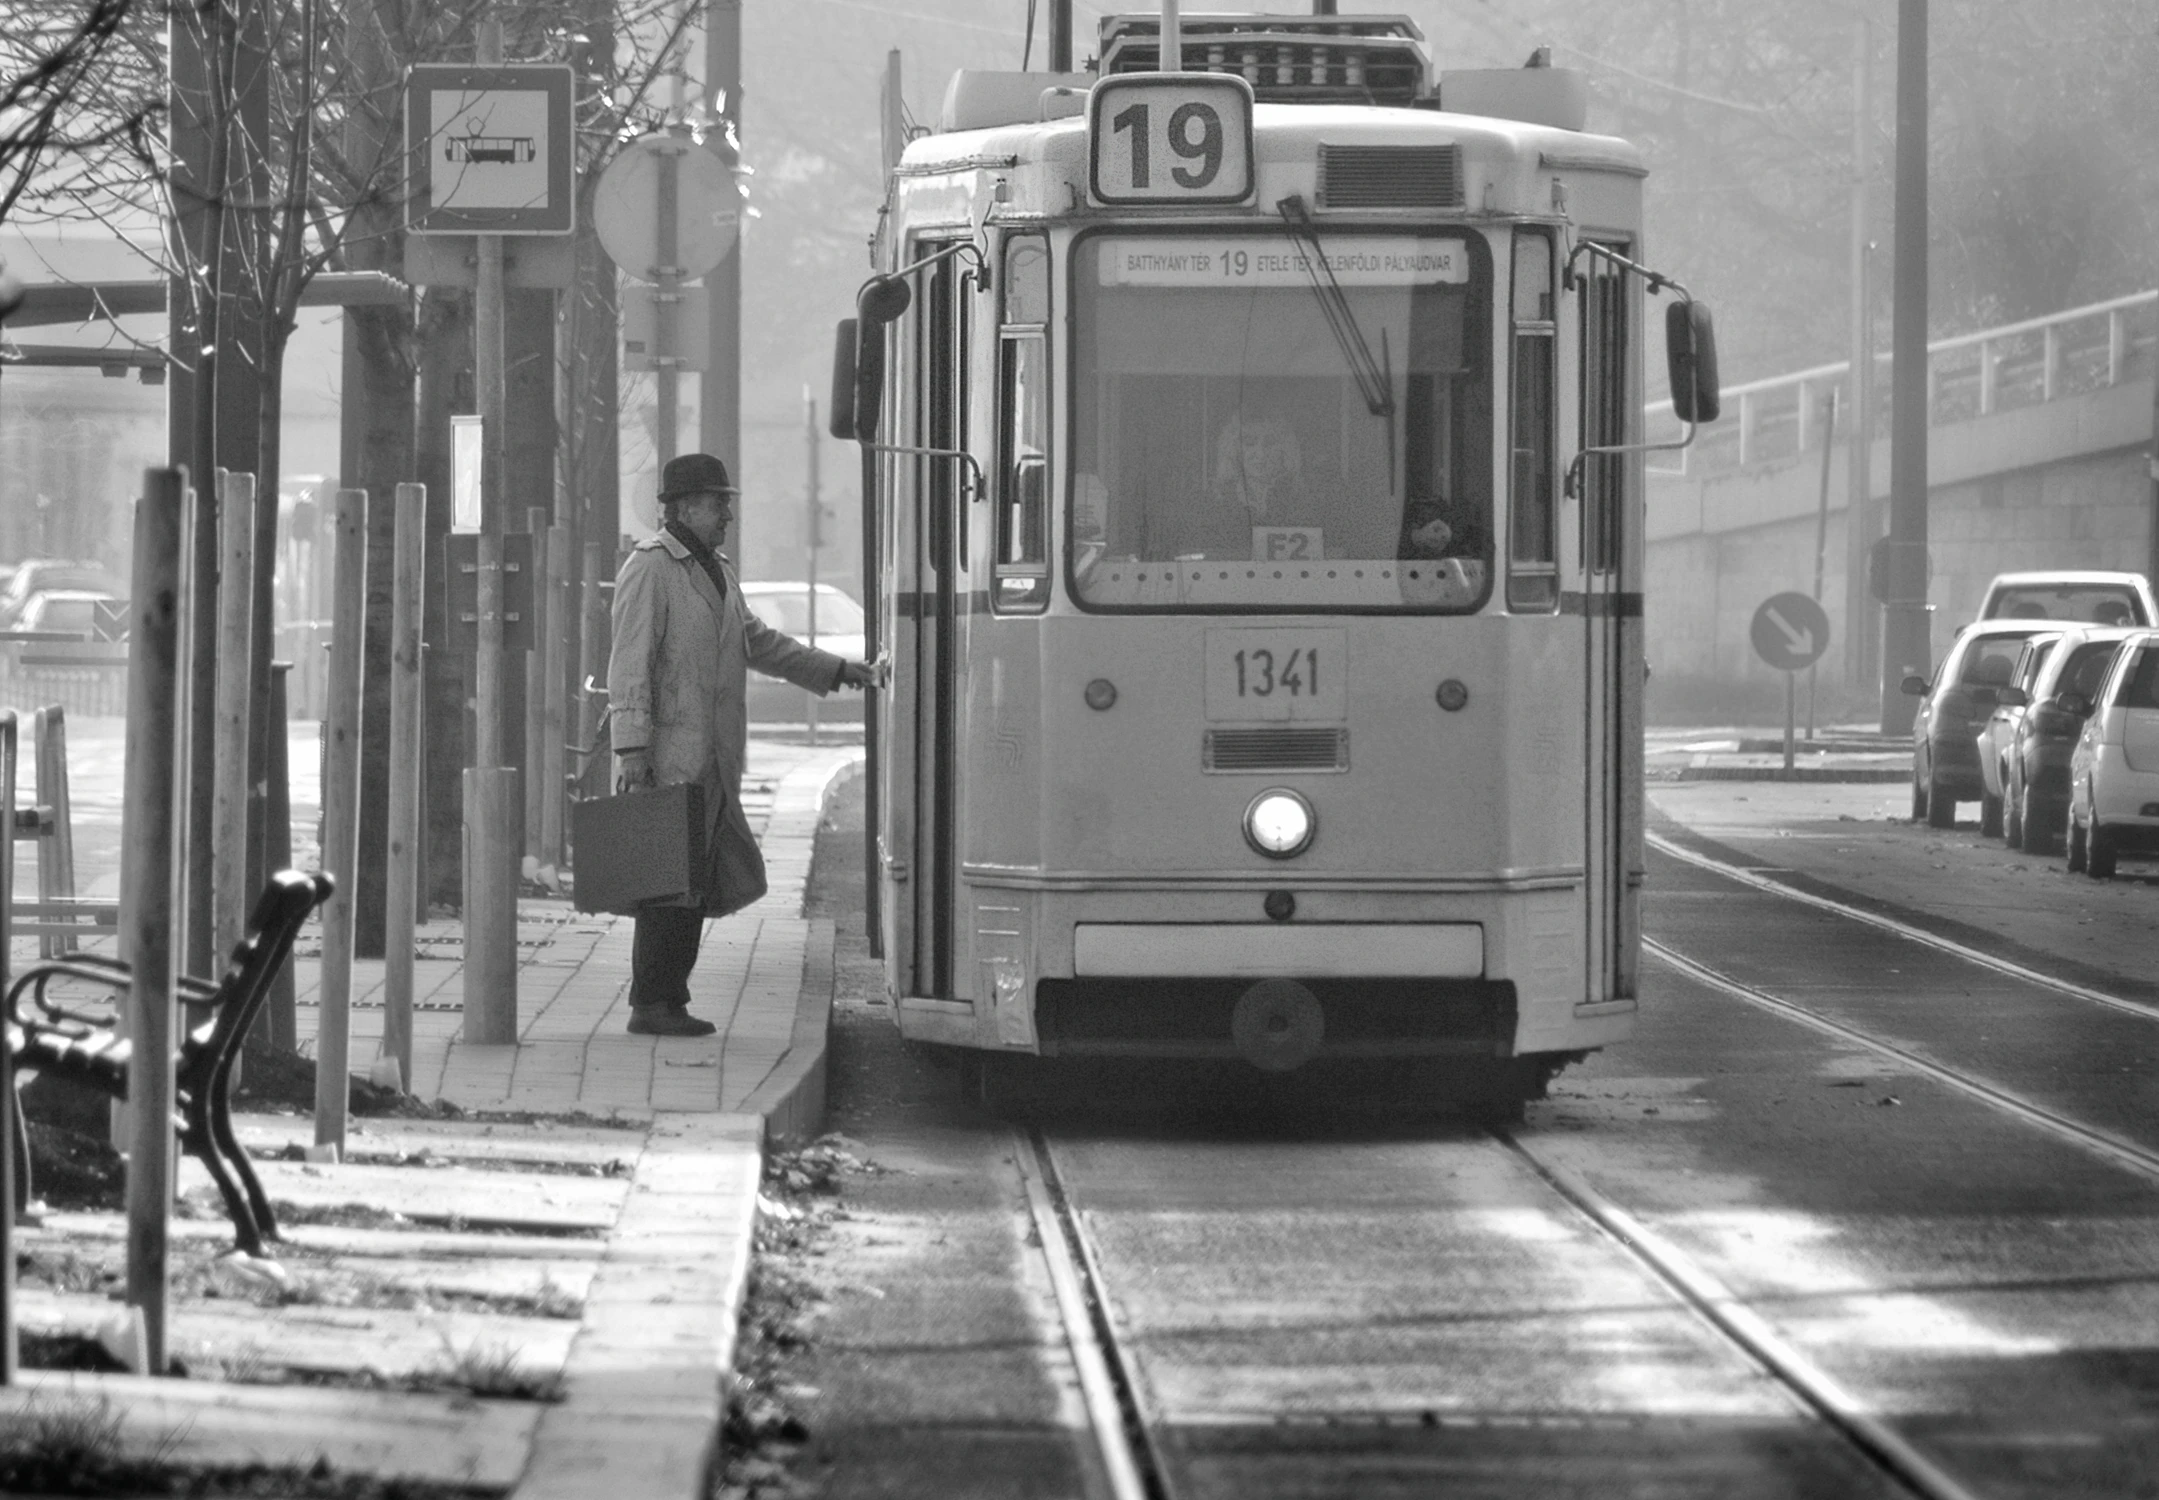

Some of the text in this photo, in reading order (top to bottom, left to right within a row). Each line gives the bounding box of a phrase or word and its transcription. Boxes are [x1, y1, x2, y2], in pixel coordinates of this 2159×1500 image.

[1113, 102, 1223, 189] 19
[1127, 251, 1189, 272] BATTHYÁNY
[1191, 251, 1211, 272] TÉR
[1219, 250, 1249, 276] 19
[1257, 255, 1289, 272] ETELE
[1385, 253, 1451, 272] PÁLYAUDVAR
[1266, 532, 1310, 561] F2
[1234, 648, 1318, 697] 1341
